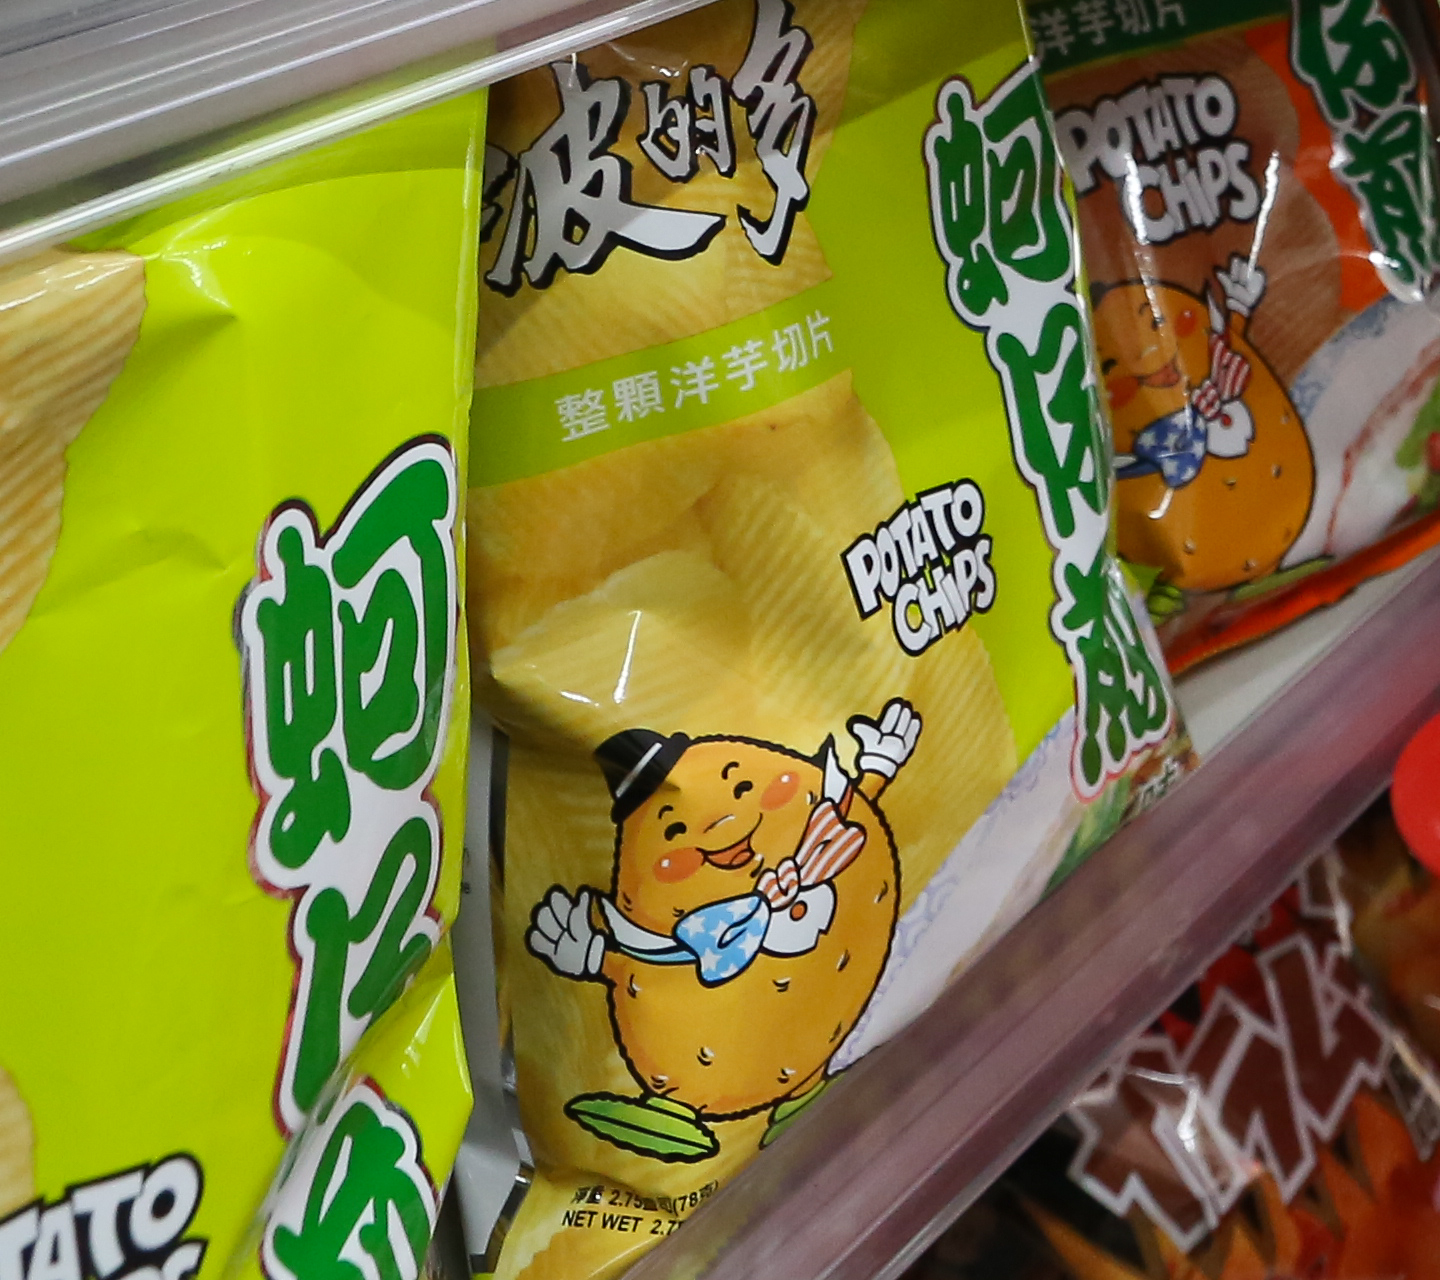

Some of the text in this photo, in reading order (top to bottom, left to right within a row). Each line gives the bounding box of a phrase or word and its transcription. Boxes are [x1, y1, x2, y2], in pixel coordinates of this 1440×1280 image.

[1054, 72, 1239, 196] POTATO
[1120, 140, 1264, 246] CHIPS
[554, 309, 836, 443] 整顆洋芋切片
[841, 478, 986, 619] POTATO
[893, 536, 999, 658] CHIPS
[561, 1209, 598, 1228] NET
[601, 1212, 644, 1233] WET
